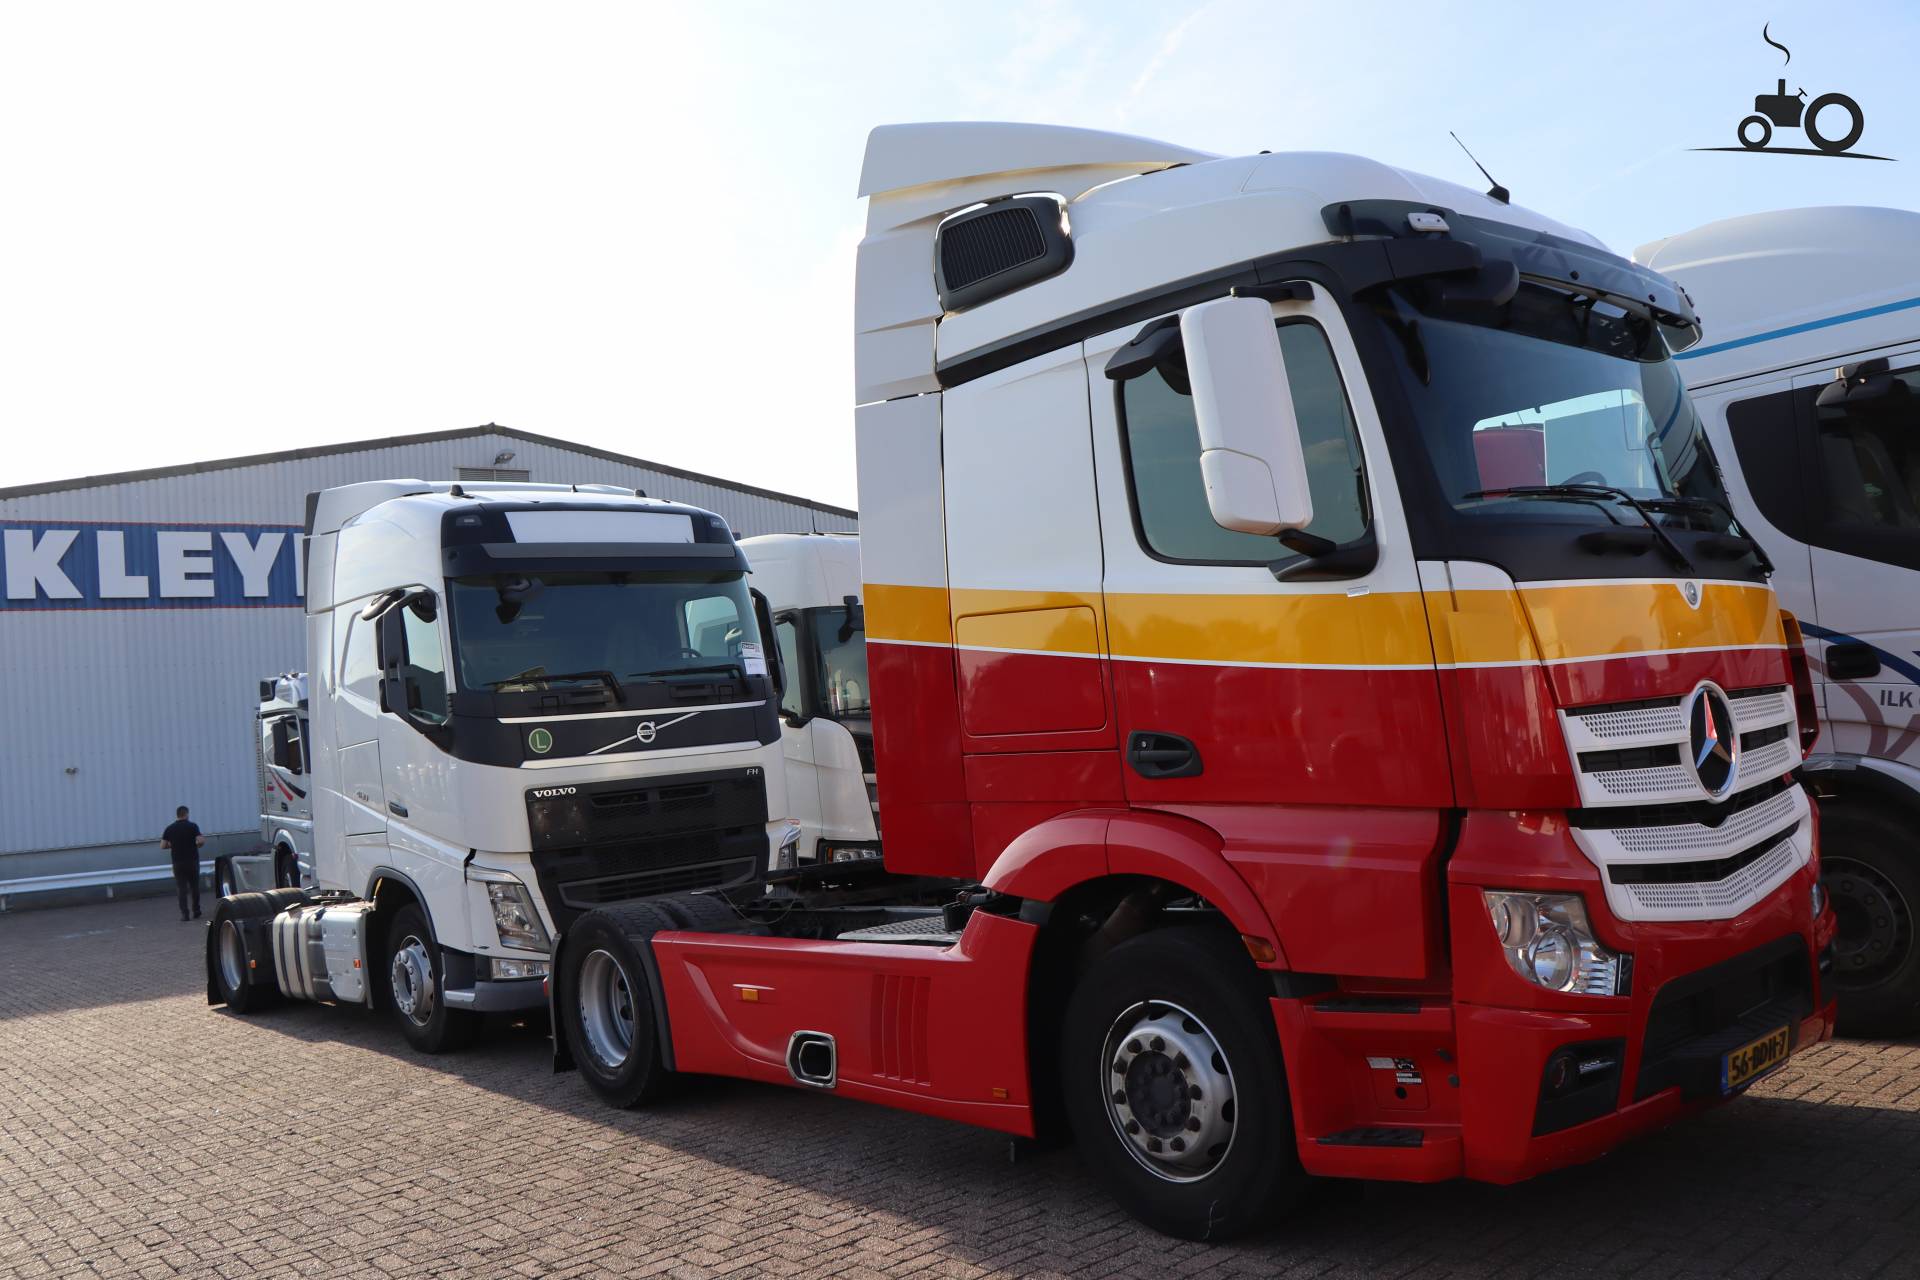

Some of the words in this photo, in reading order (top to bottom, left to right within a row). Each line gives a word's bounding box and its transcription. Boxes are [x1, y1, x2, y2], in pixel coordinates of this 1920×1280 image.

[4, 529, 305, 599] KLEY
[1880, 689, 1913, 708] ILK
[536, 734, 547, 749] L
[746, 768, 759, 776] FH
[533, 787, 577, 798] VOLVO
